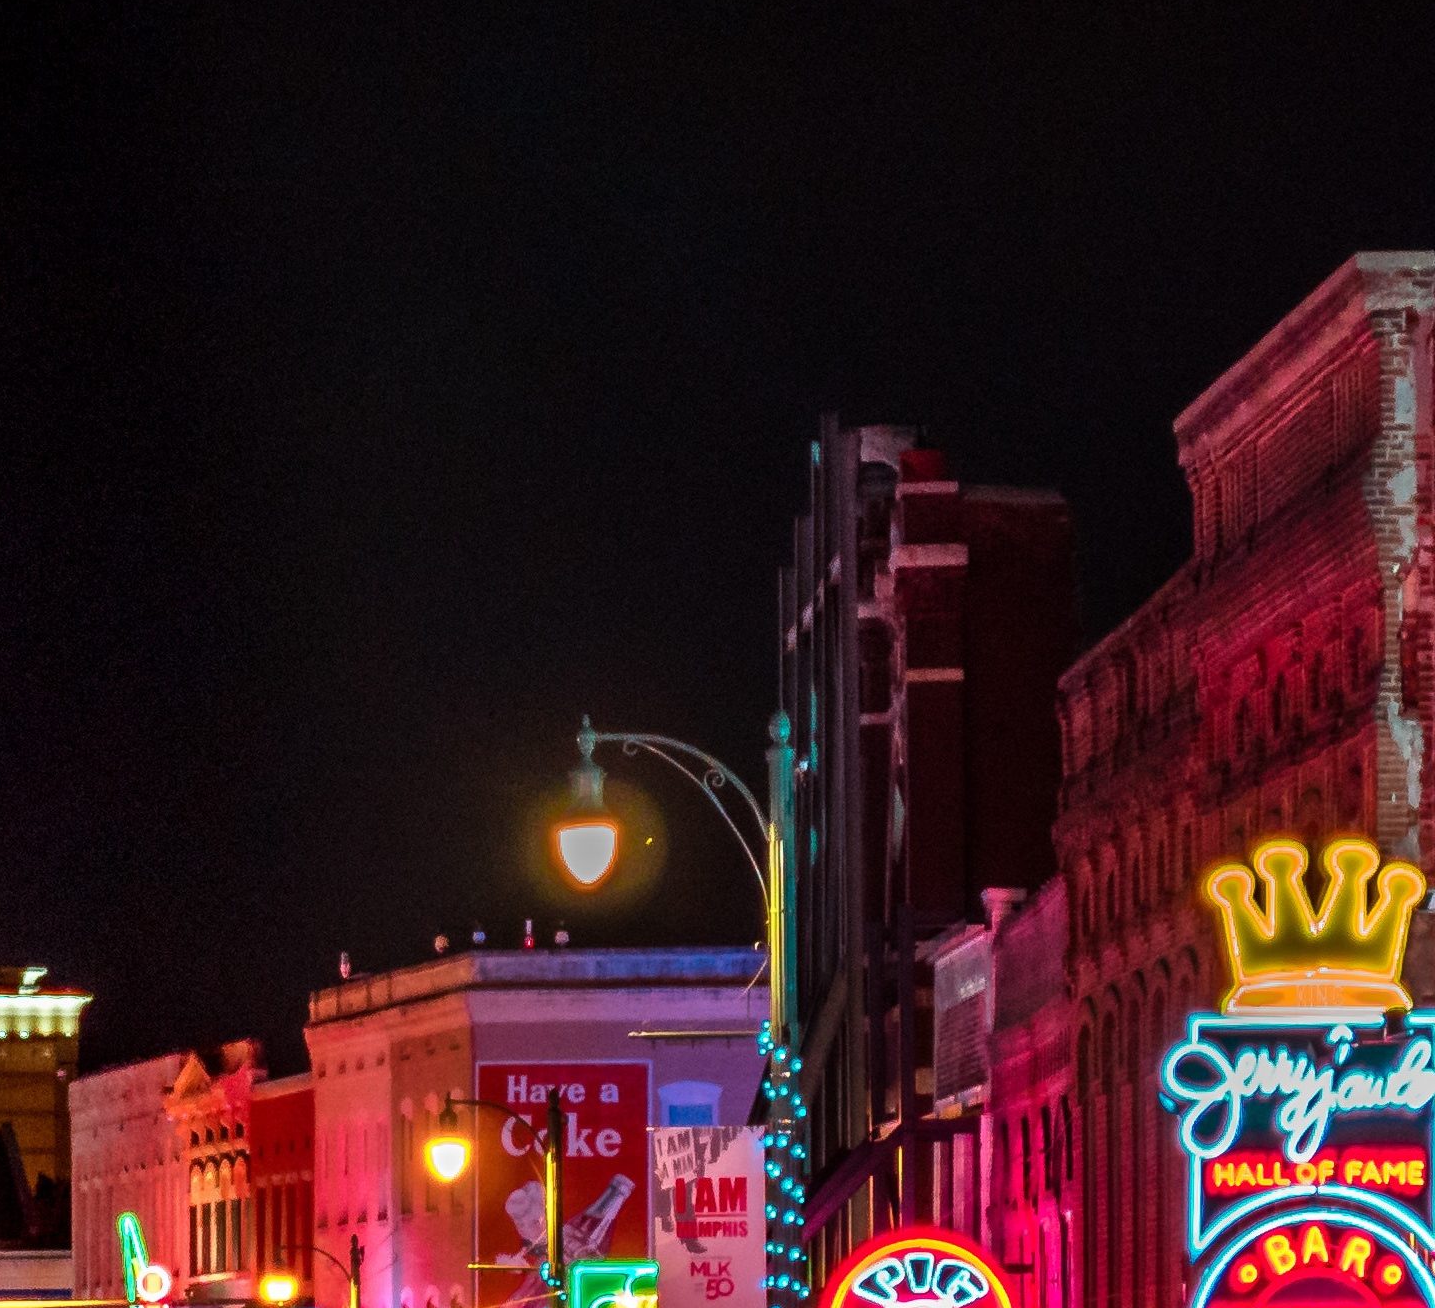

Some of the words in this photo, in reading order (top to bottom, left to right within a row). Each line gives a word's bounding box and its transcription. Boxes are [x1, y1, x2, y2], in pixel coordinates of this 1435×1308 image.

[506, 1075, 587, 1104] Have
[600, 1082, 620, 1103] a
[1214, 1161, 1292, 1187] HALL
[1295, 1161, 1334, 1186] OF
[1344, 1159, 1424, 1187] FAME
[675, 1177, 687, 1214] I
[694, 1176, 748, 1213] AM
[676, 1219, 749, 1239] MEMPHIS
[1265, 1226, 1373, 1279] BAR
[689, 1260, 732, 1278] MLK
[852, 1252, 989, 1308] PIG
[705, 1277, 735, 1300] 50
